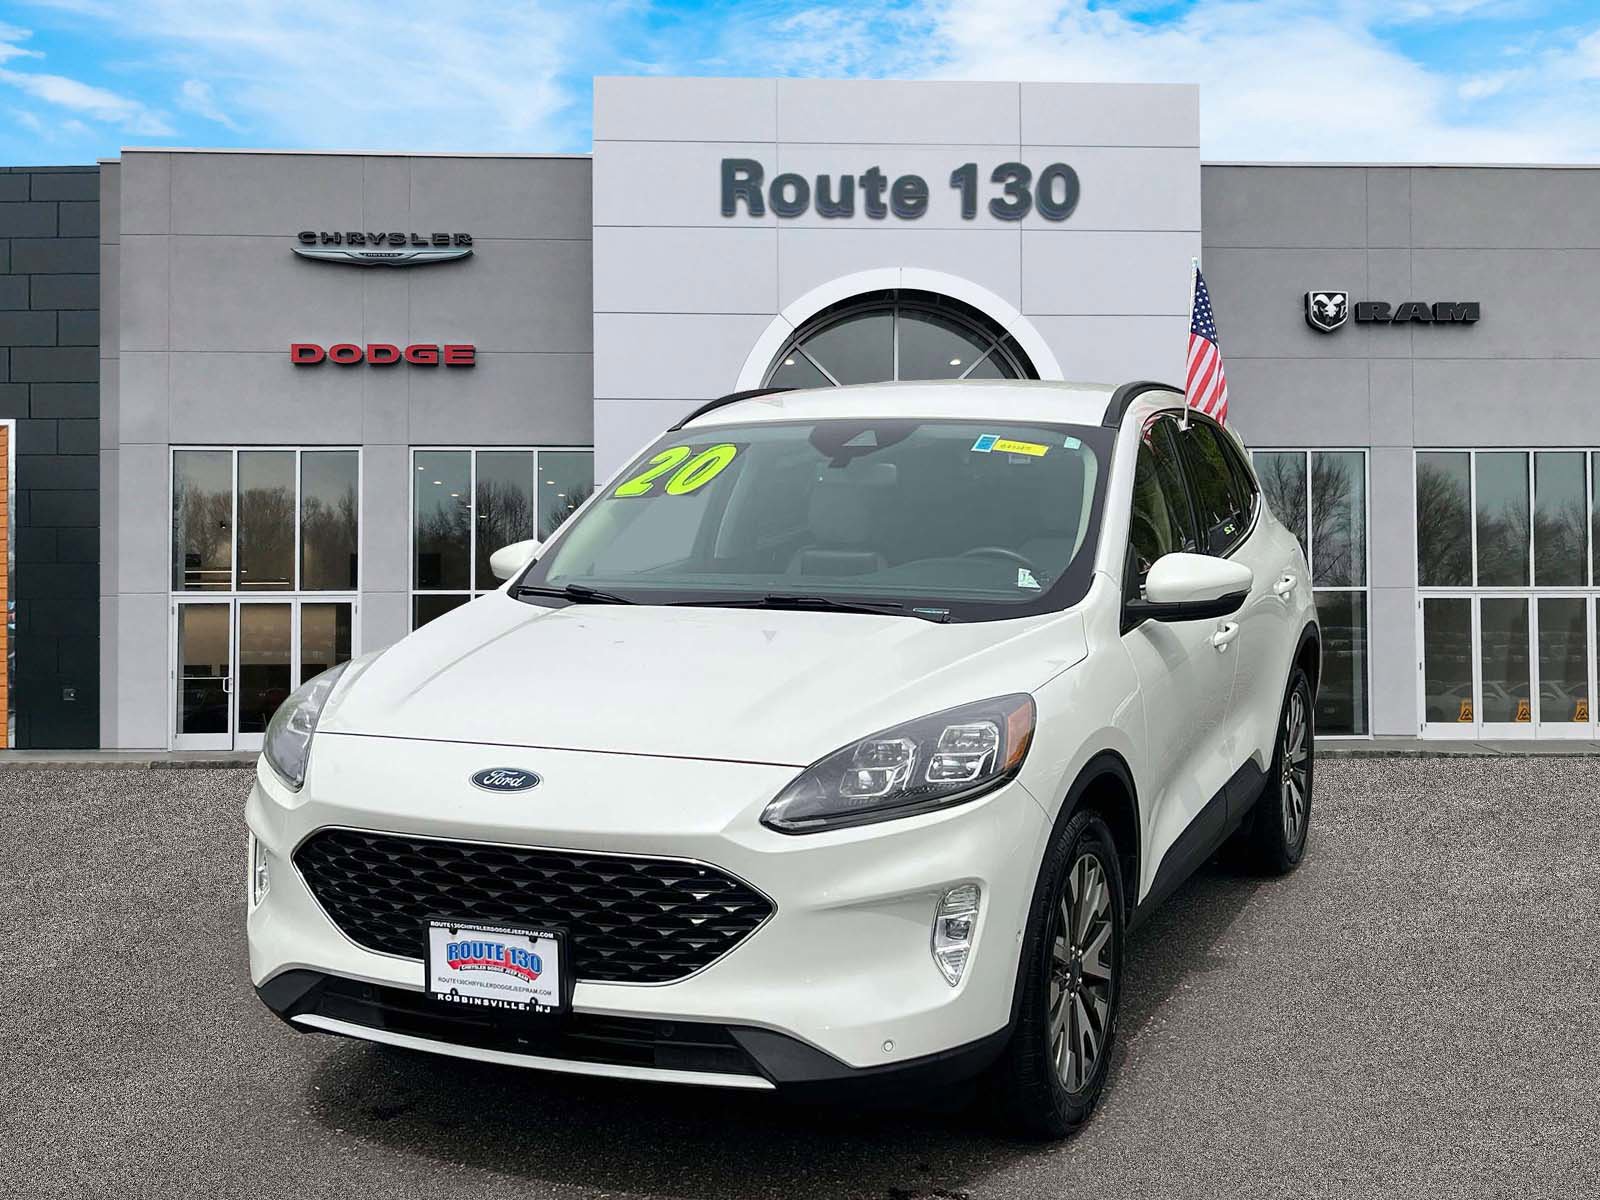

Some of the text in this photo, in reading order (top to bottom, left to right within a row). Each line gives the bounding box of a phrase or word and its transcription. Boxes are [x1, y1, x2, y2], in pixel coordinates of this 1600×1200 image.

[721, 158, 1081, 221] Route 130
[297, 231, 473, 246] CHRYSLER
[1355, 302, 1481, 325] RAM
[290, 343, 476, 366] DODGE
[613, 443, 738, 498] 20
[483, 770, 527, 787] Ford
[447, 940, 543, 974] ROUTE 130
[437, 993, 551, 1014] ROBBINSVILLE, NJ
